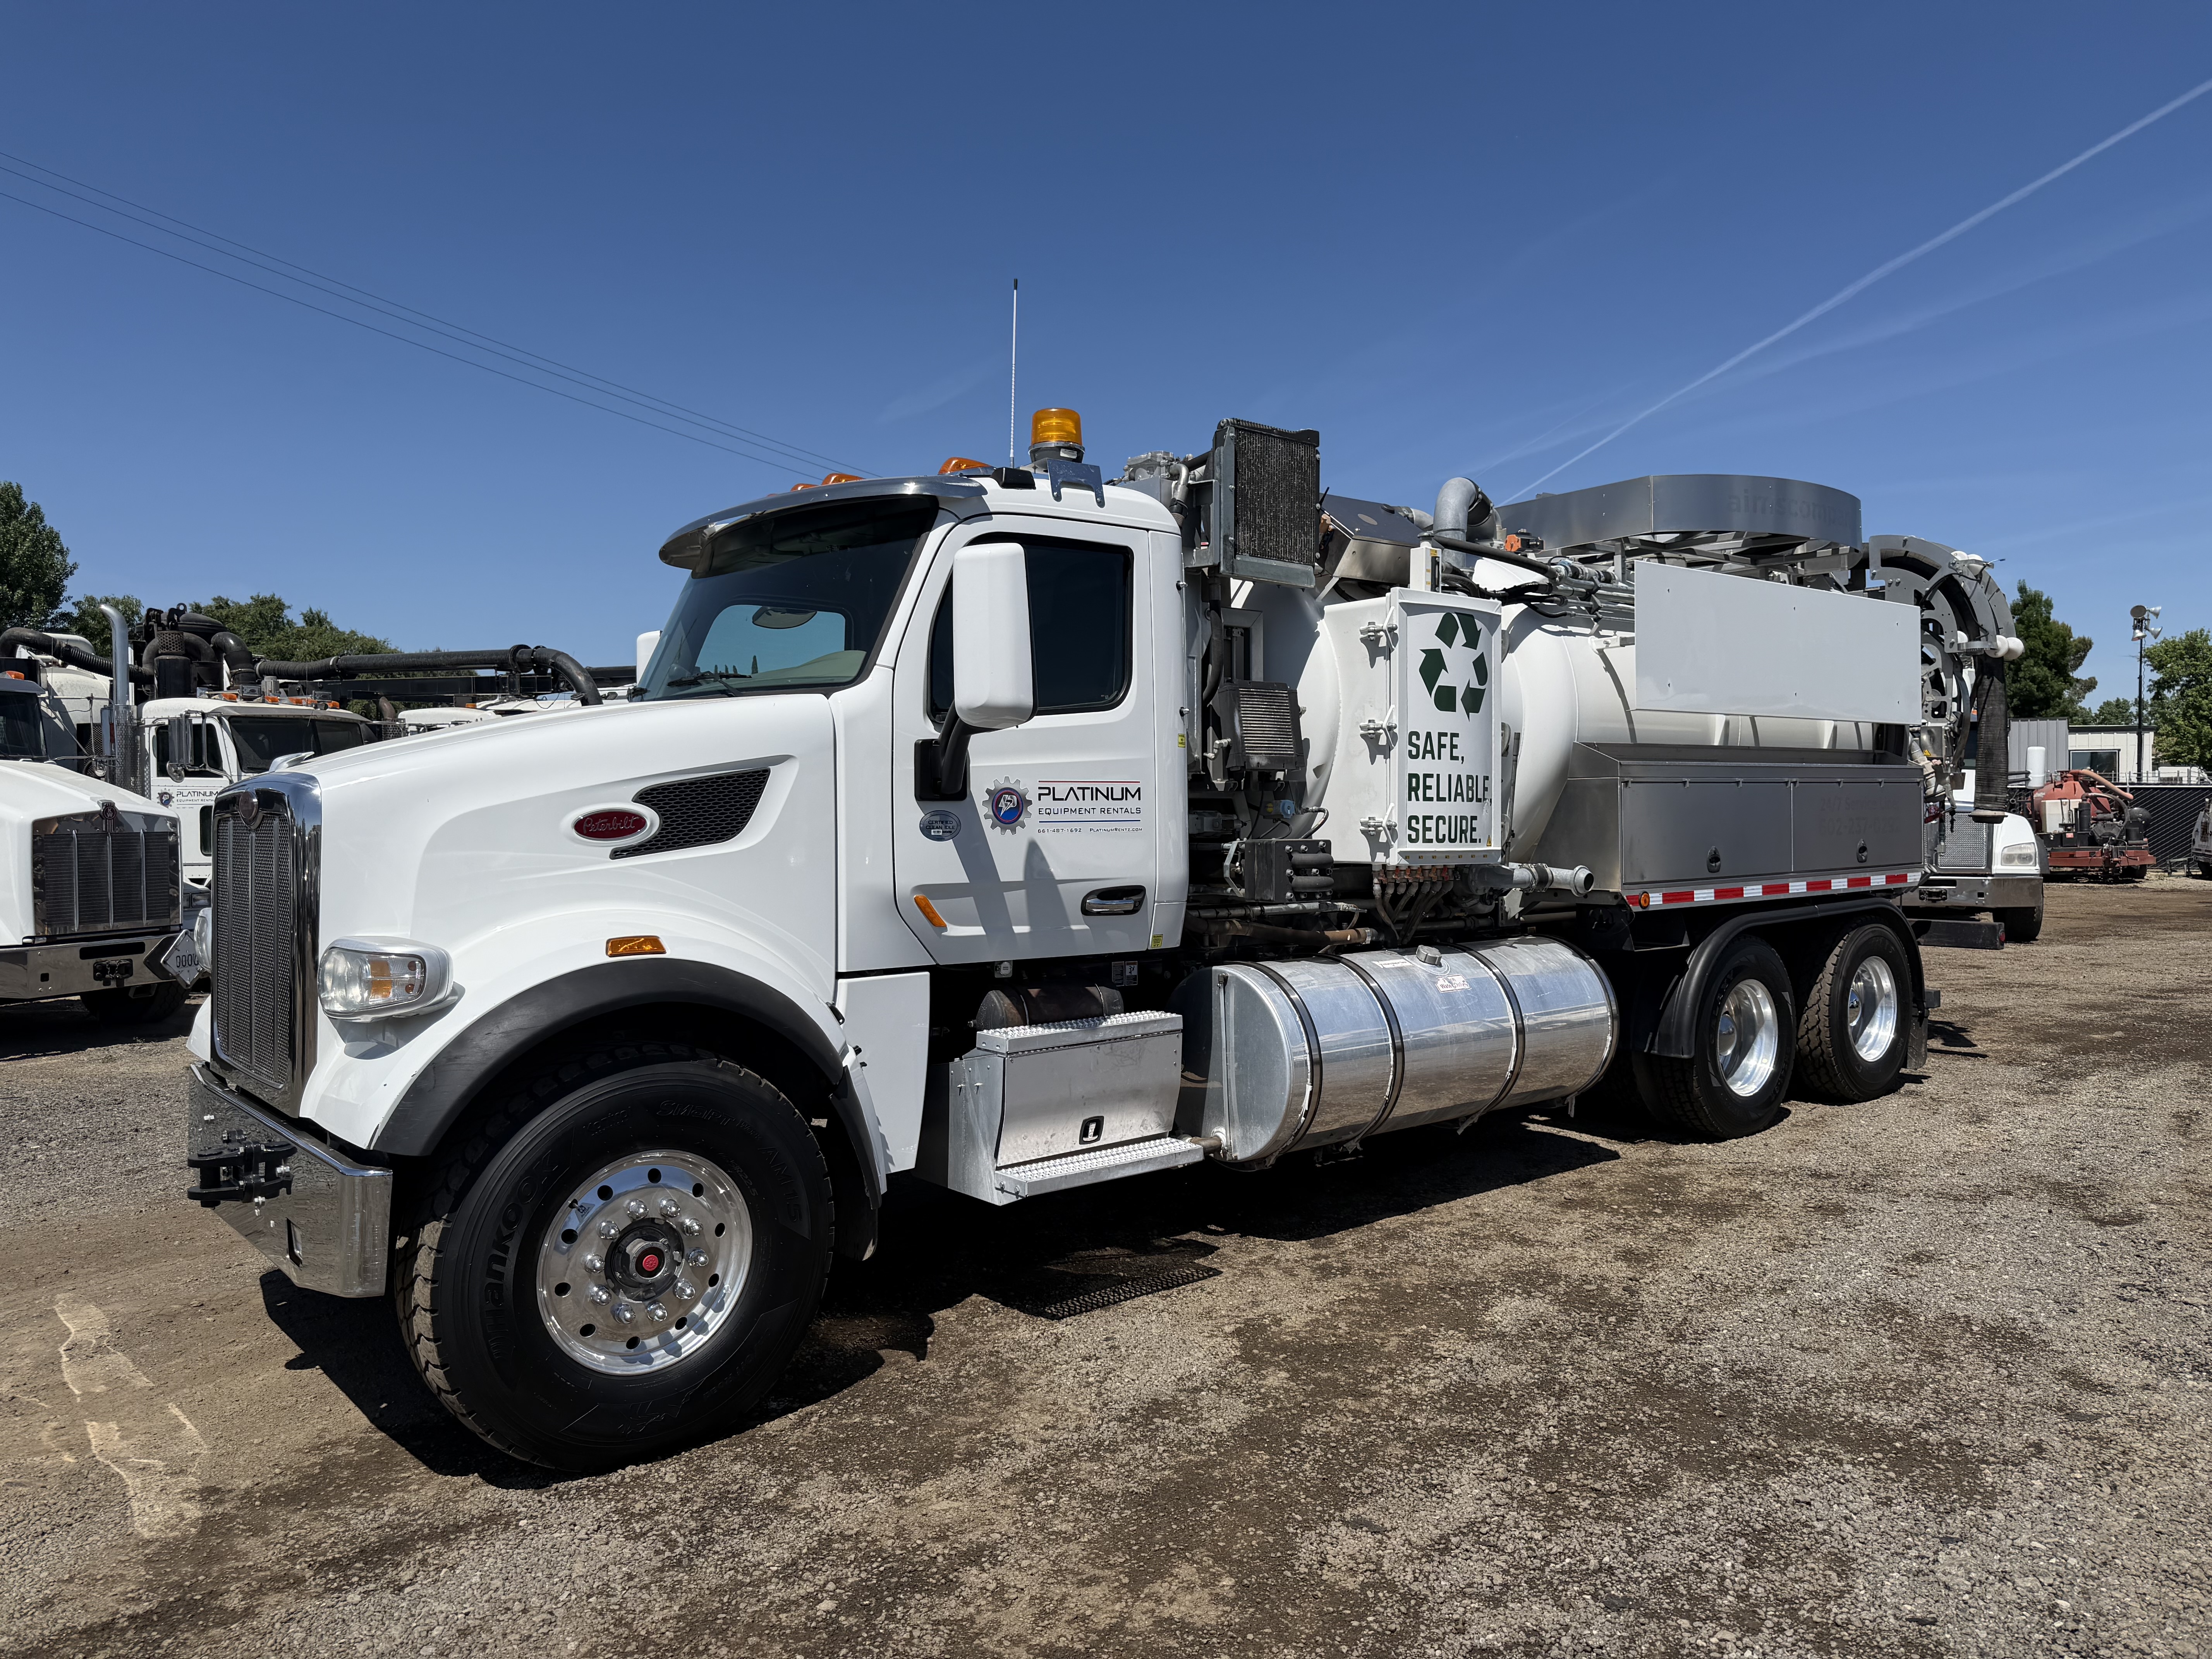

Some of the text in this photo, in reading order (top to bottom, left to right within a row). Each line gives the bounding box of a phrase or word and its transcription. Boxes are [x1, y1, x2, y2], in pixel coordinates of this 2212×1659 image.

[1408, 731, 1464, 764] SAFE,
[1038, 787, 1141, 801] PLATINUM
[1408, 773, 1492, 805] RELIABLE,
[1039, 808, 1096, 816] EQUIPMENT
[583, 816, 639, 834] Peterbilt
[1408, 815, 1481, 843] SECURE.
